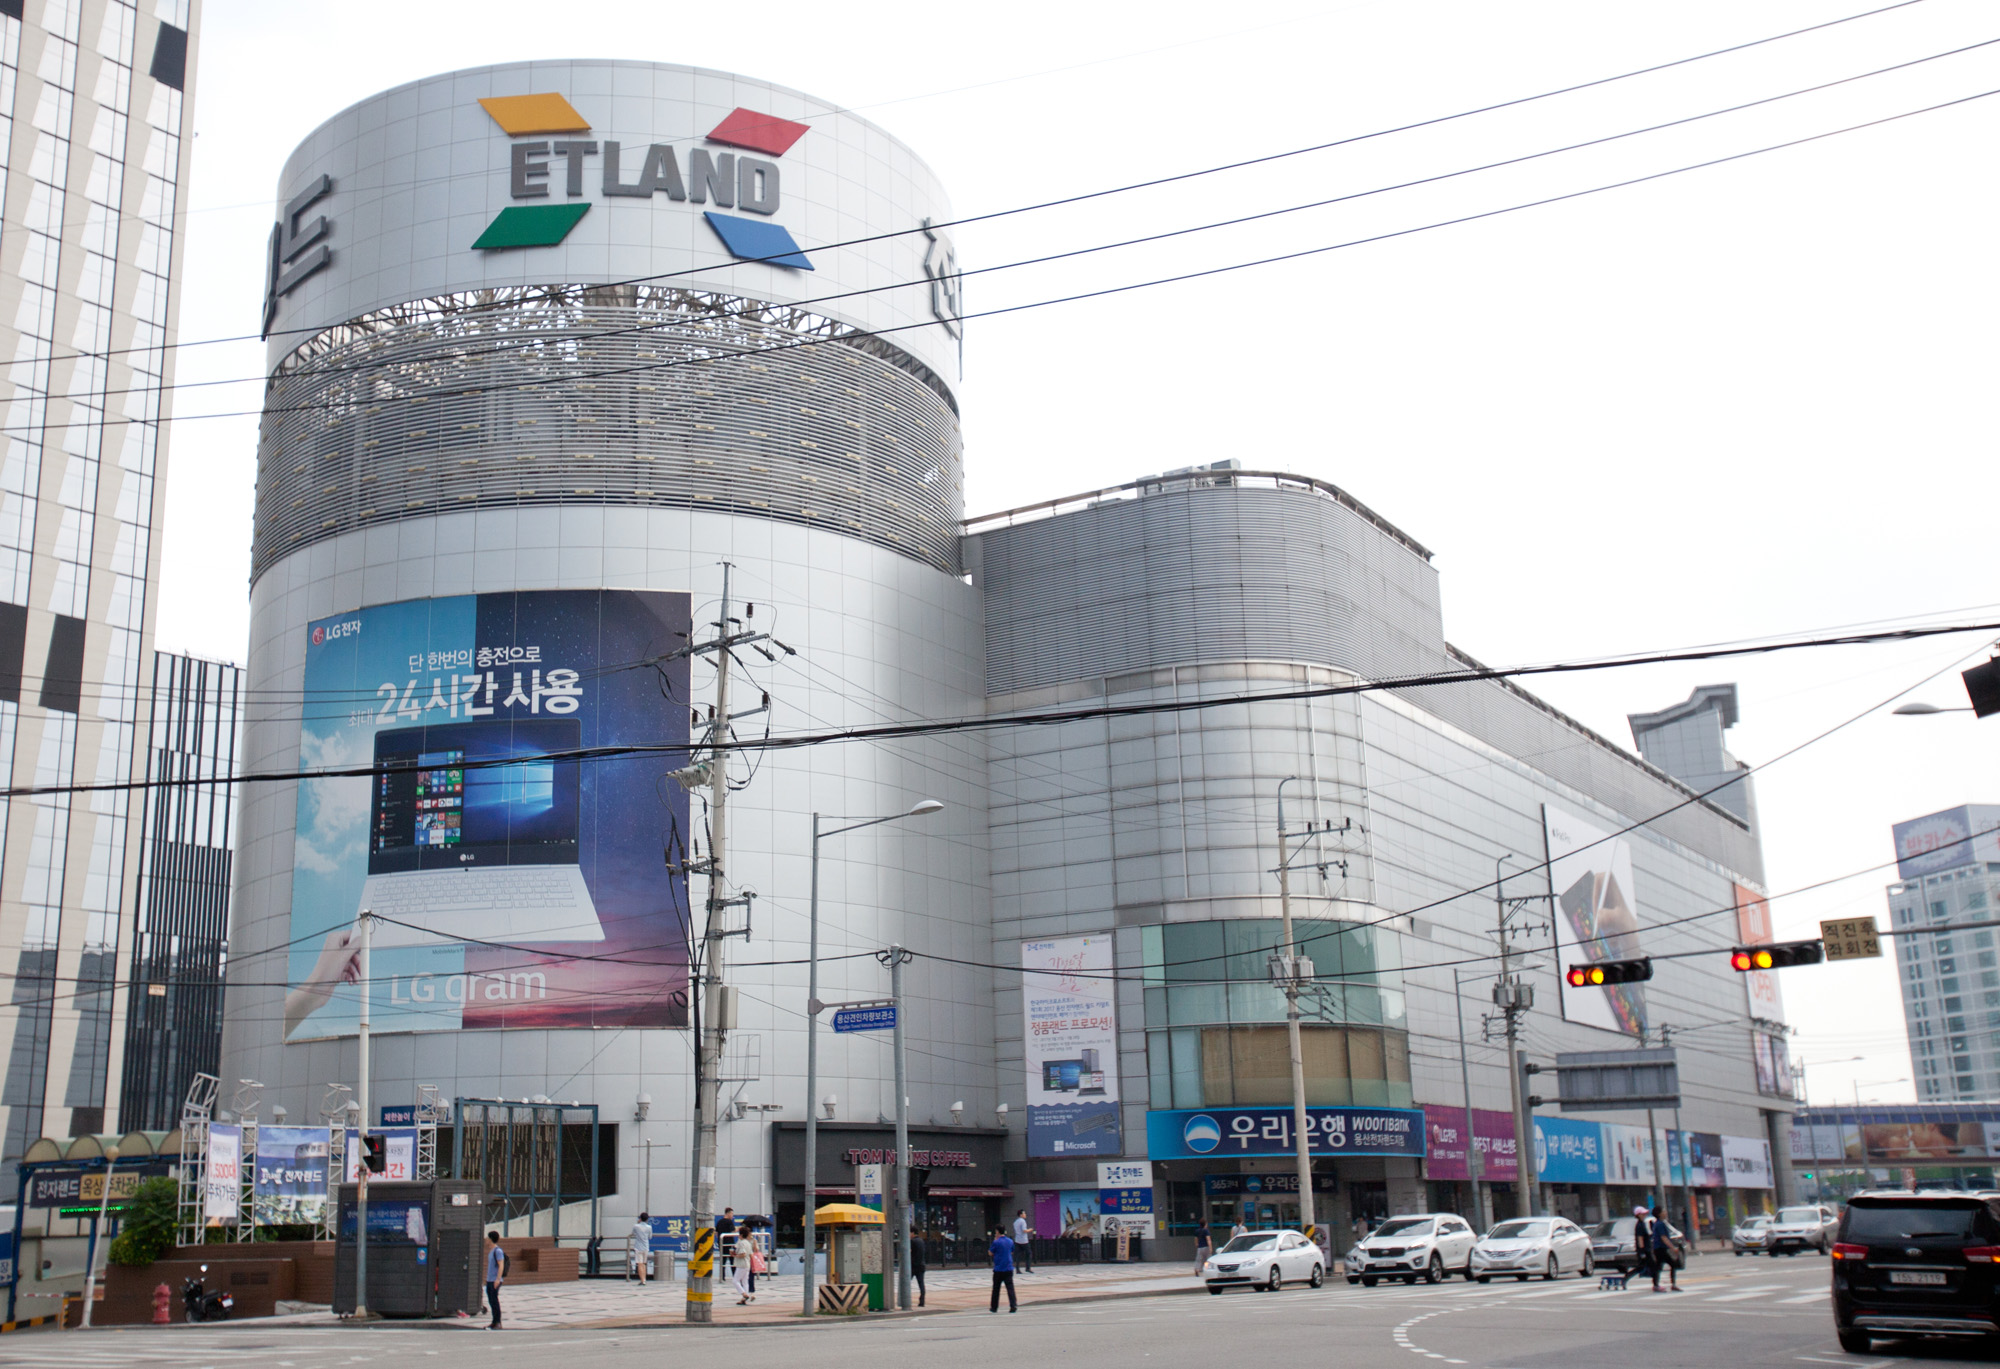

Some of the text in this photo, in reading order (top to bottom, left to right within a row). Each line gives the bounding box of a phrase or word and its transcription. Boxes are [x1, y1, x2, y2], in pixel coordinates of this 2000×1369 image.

[510, 140, 780, 216] ETLAND
[326, 620, 362, 641] LG전자
[409, 645, 542, 673] 단 한번의 충전으로
[348, 667, 584, 729] 최대 24시간 사용
[390, 971, 546, 1013] LG gram
[1031, 1016, 1113, 1036] 정품랜드 프로모션!
[1228, 1114, 1347, 1149] 우리은행
[1065, 1140, 1097, 1150] Microsoft
[849, 1148, 883, 1165] TOM
[931, 1151, 971, 1167] COFFEE
[284, 1170, 323, 1183] 전자랜드
[37, 1179, 79, 1199] 전자랜드
